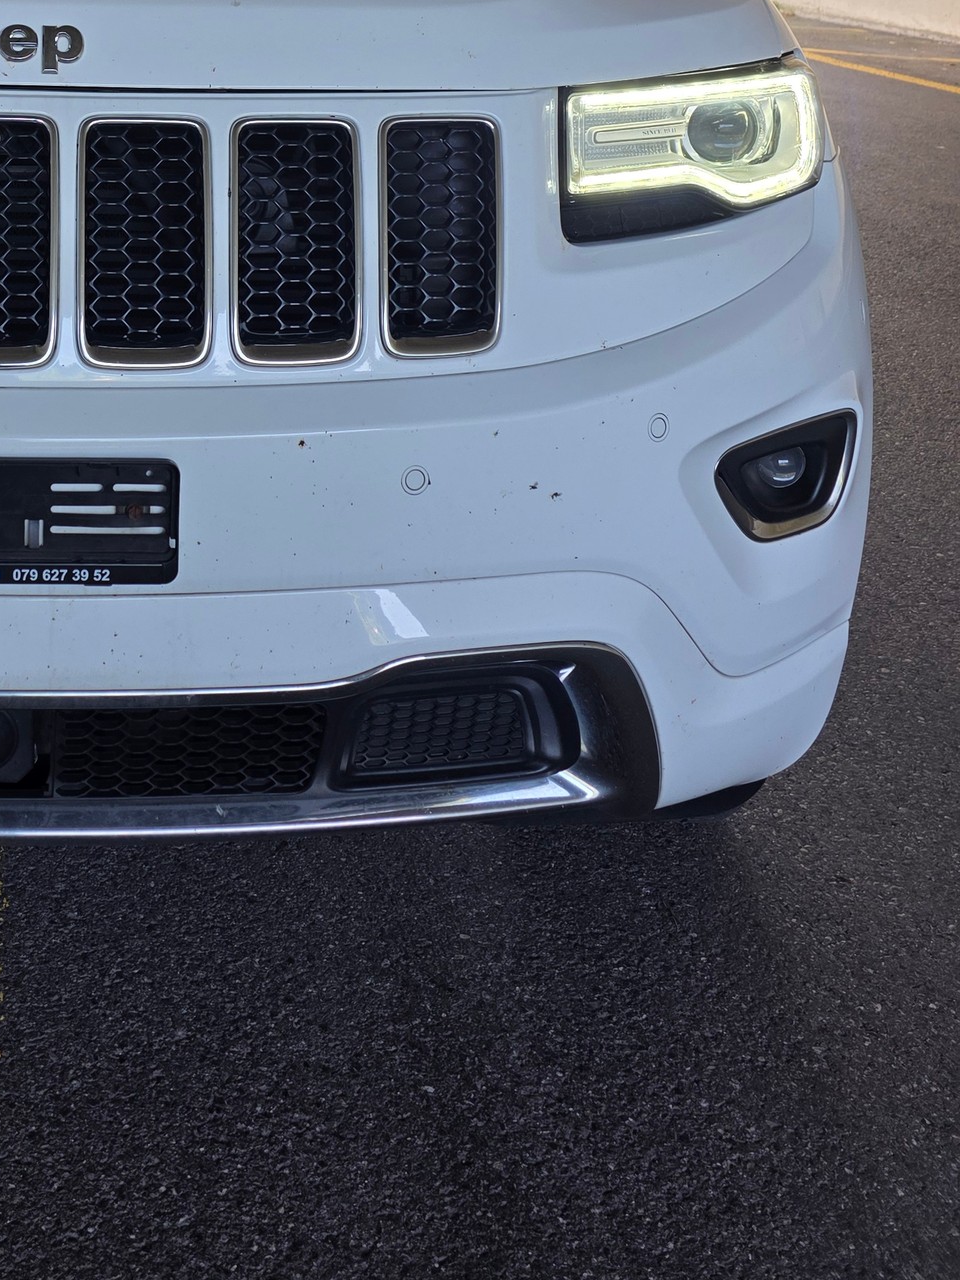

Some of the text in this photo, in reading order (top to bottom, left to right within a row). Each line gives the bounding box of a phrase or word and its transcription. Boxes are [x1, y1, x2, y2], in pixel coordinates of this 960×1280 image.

[12, 569, 38, 581] 079
[42, 569, 68, 581] 627
[72, 569, 89, 581] 39
[93, 569, 110, 581] 52
